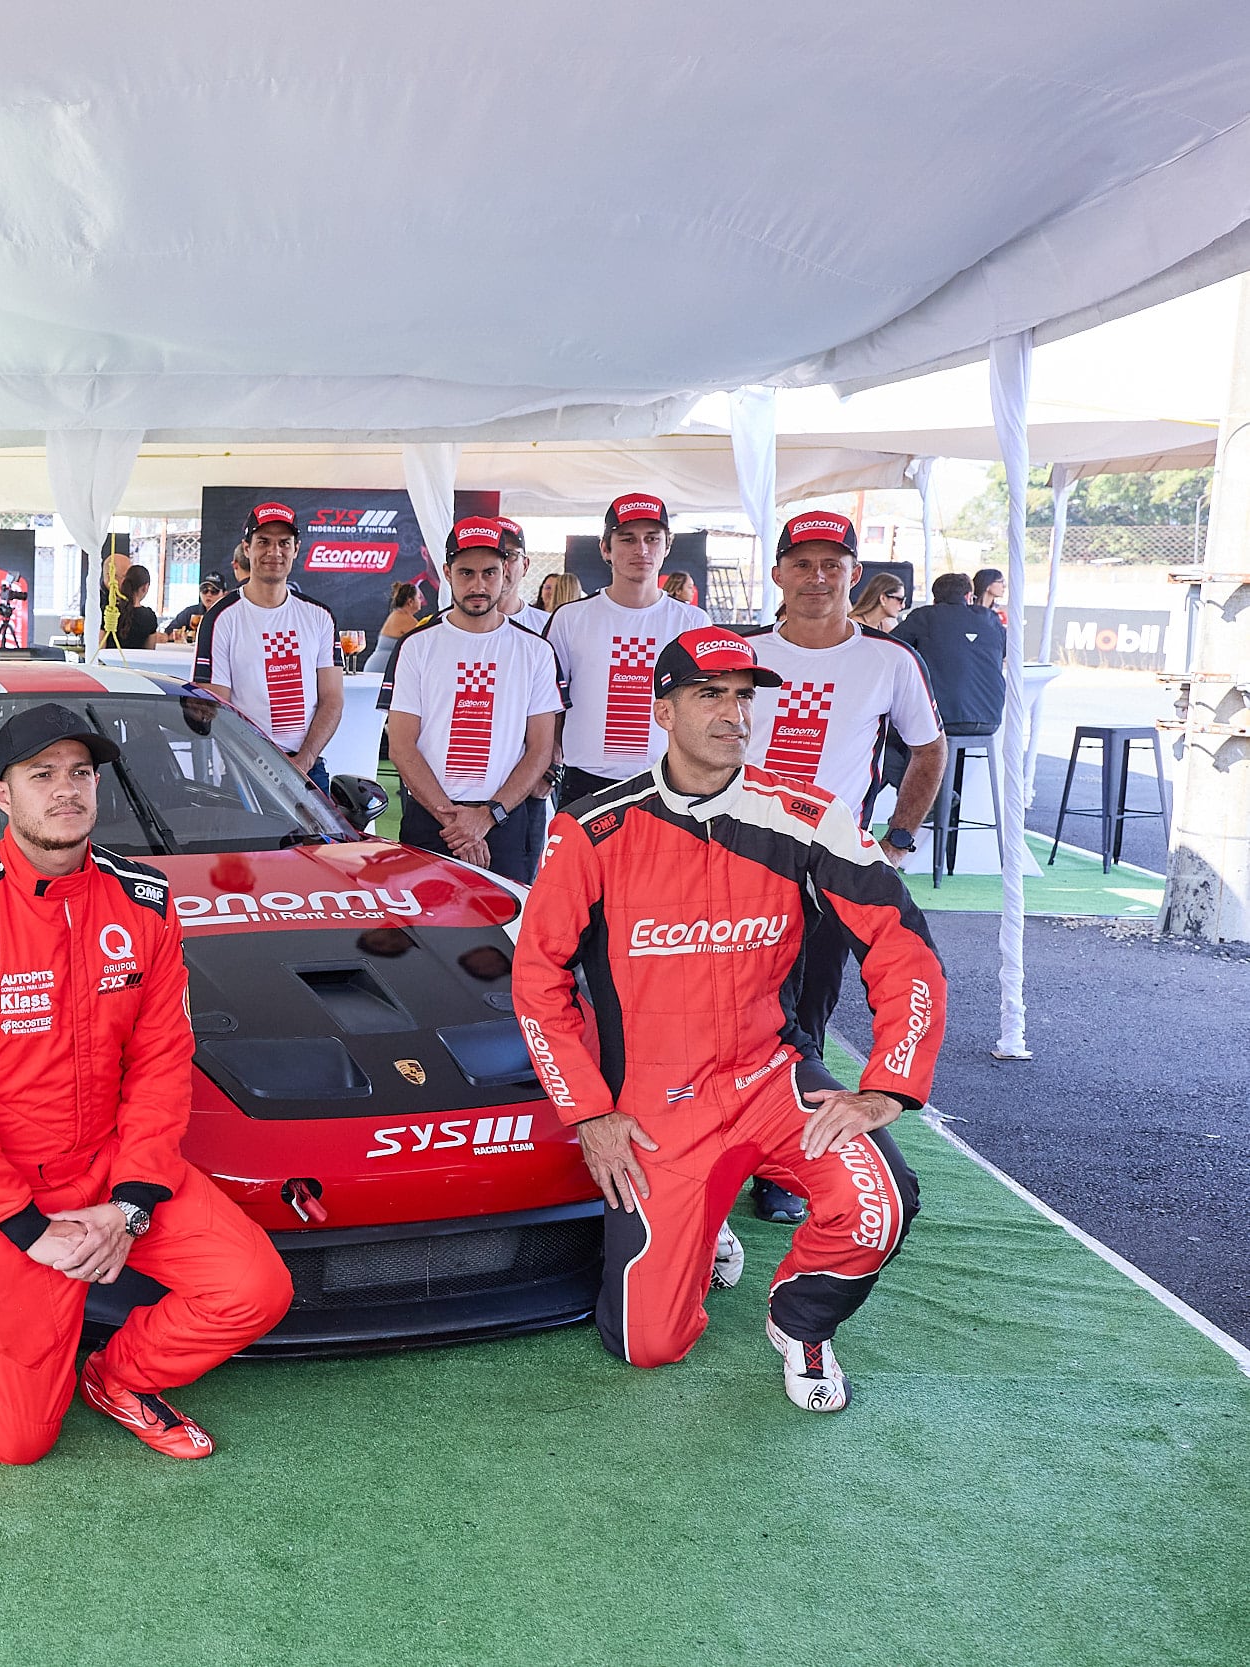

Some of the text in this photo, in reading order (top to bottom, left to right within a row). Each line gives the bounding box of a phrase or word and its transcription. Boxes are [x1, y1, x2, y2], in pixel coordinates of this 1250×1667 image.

[619, 501, 660, 513] Economy
[307, 525, 357, 533] ENDEREZADO
[365, 526, 398, 534] PINTURA
[459, 526, 499, 540] Economy
[793, 520, 846, 534] Economy
[311, 545, 391, 569] Economy
[1064, 621, 1160, 654] Mobil
[695, 639, 752, 657] Economy
[777, 725, 822, 738] Economy
[791, 800, 819, 817] OMP
[591, 814, 617, 834] OMP
[135, 885, 164, 901] OMP
[173, 888, 422, 917] onomy
[283, 910, 385, 922] Rent a Car
[630, 914, 789, 948] Economy
[99, 923, 135, 961] Q
[712, 940, 762, 953] Rent a Car
[0, 992, 50, 1010] Klass
[11, 1016, 52, 1030] ROOSTER
[884, 978, 930, 1075] Economy
[524, 1017, 576, 1107] Economy
[473, 1142, 535, 1156] RACING TEAM
[837, 1141, 883, 1249] Economy
